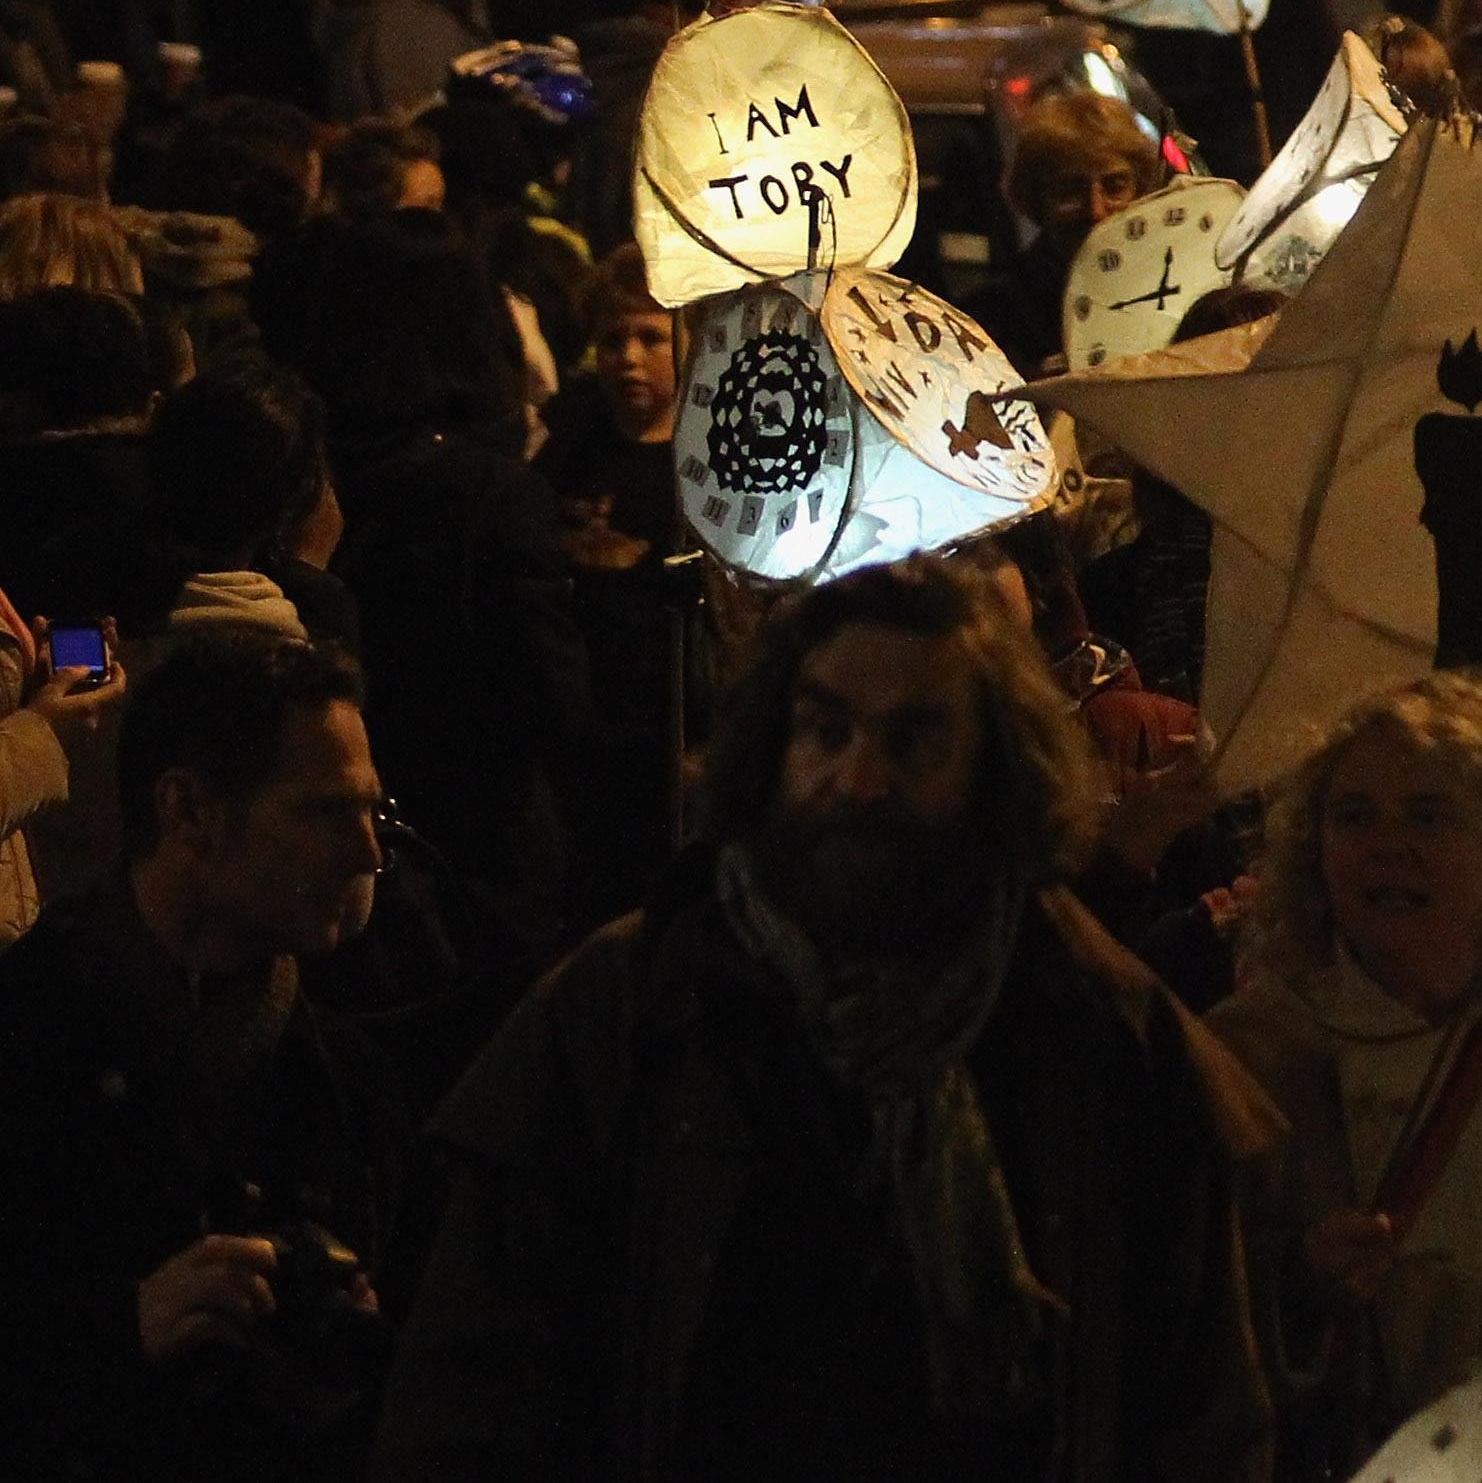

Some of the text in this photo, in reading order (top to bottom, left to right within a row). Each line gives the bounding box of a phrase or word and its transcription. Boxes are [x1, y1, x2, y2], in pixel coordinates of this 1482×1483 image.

[706, 83, 822, 155] I AM
[708, 153, 854, 220] TOBY
